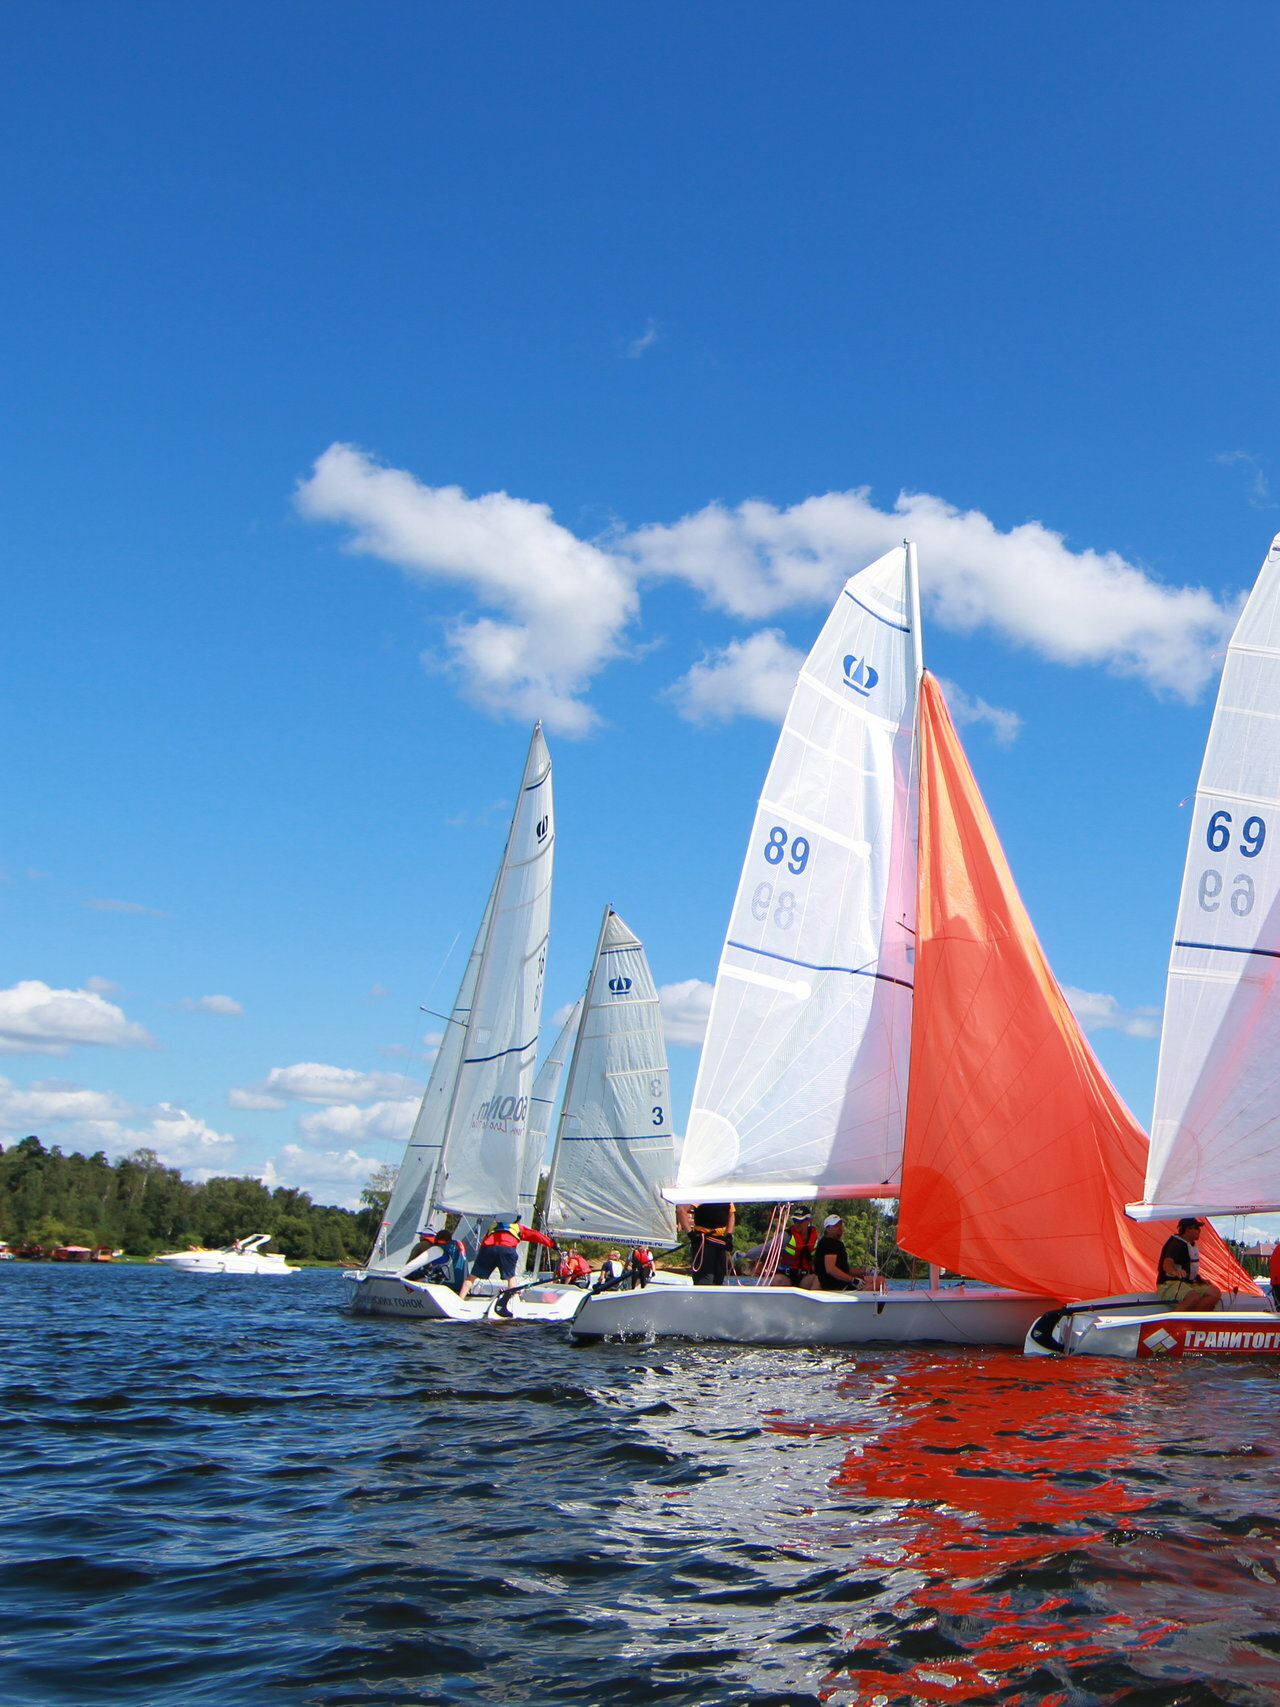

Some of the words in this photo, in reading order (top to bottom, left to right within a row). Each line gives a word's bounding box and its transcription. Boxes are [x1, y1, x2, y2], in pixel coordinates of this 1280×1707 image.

[1207, 810, 1266, 858] 69
[764, 826, 810, 875] 89
[652, 1106, 664, 1126] 3
[580, 1233, 663, 1247] www.nationalclass.ru
[393, 1297, 425, 1309] ГОНОК
